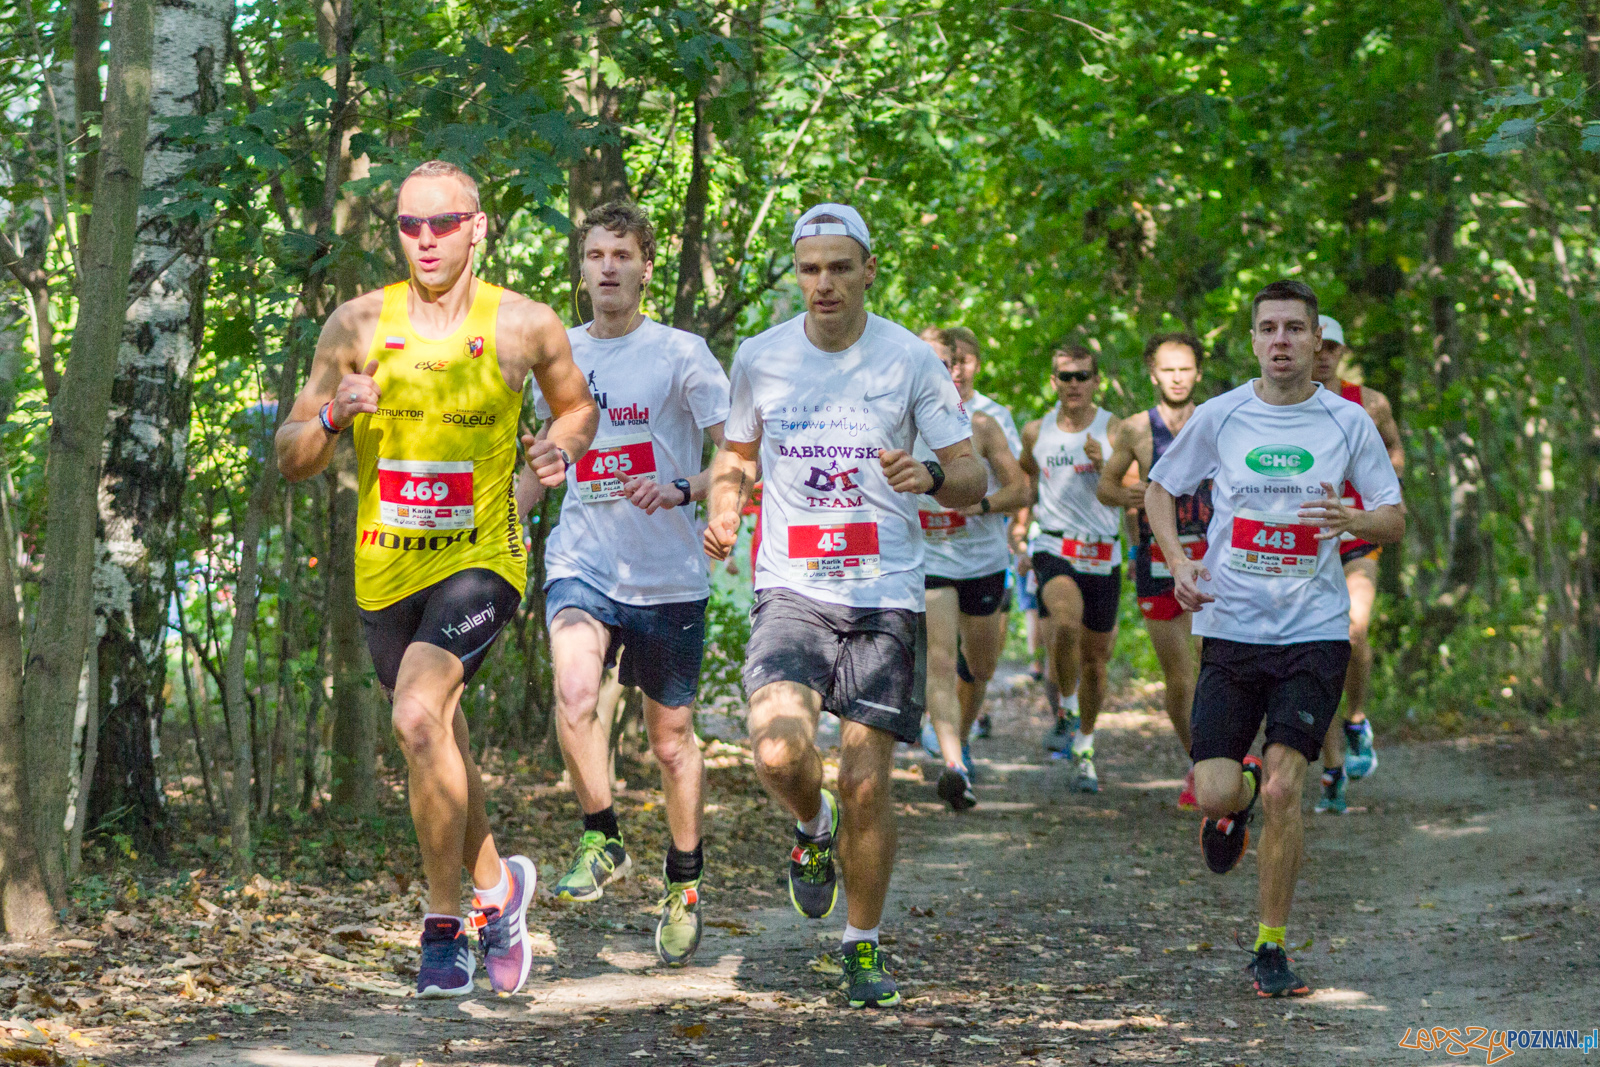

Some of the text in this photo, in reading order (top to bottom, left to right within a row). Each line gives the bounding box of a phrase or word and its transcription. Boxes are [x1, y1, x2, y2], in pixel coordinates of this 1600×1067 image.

[376, 408, 424, 418] STRUKTOR
[781, 420, 826, 430] Borowo
[592, 453, 633, 475] 495
[1046, 455, 1074, 467] RUN
[1260, 454, 1301, 468] CHC
[401, 480, 449, 501] 469
[1264, 485, 1302, 494] Health
[806, 496, 863, 508] TEAM
[817, 532, 847, 552] 45
[1252, 529, 1296, 550] 443
[441, 601, 496, 640] Kalenji
